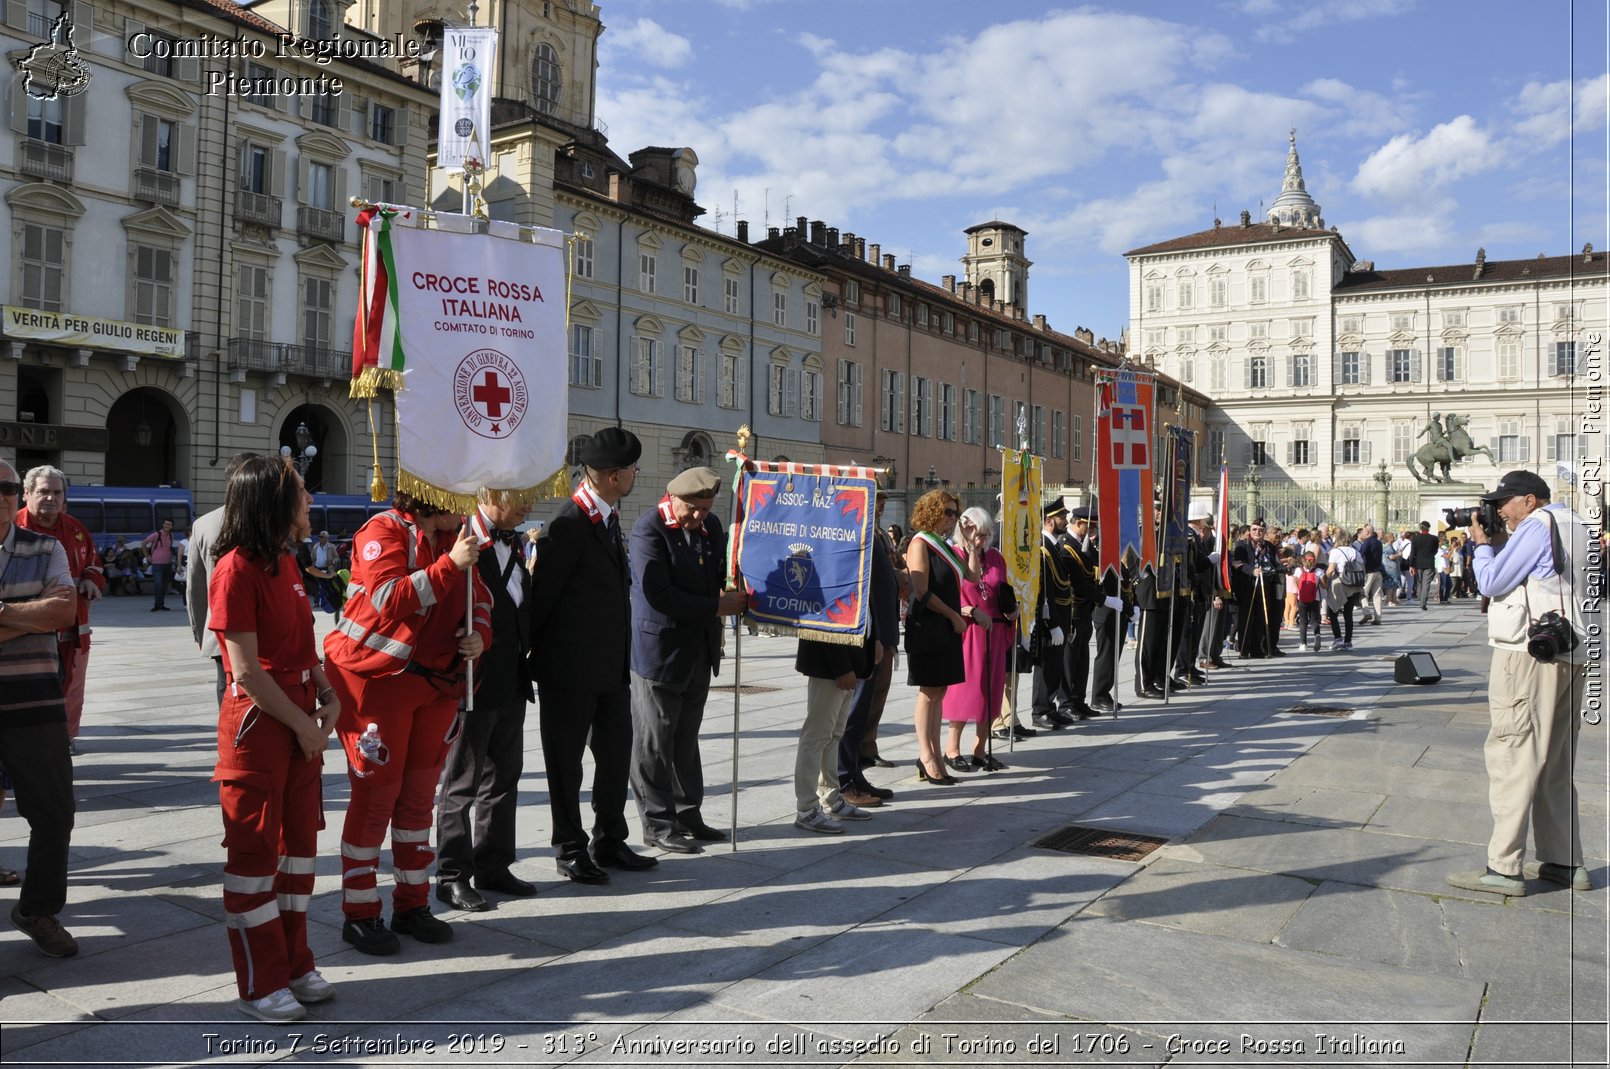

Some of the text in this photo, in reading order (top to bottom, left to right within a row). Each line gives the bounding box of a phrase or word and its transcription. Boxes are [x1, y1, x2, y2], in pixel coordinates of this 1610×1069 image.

[412, 272, 544, 303] CROCE ROSSA
[442, 298, 522, 323] ITALIANA
[12, 311, 177, 345] VERITÀ PER GIULIO REGENI
[434, 321, 535, 339] COMITATO DI TORINO
[466, 357, 478, 371] DI
[476, 352, 509, 372] GINEVRA
[507, 367, 518, 379] 22
[457, 367, 482, 428] CONVENZIONE
[513, 380, 526, 413] AGOSTO
[748, 519, 857, 542] GRANATIERI DI SARDEGNA
[767, 595, 823, 615] TORINO
